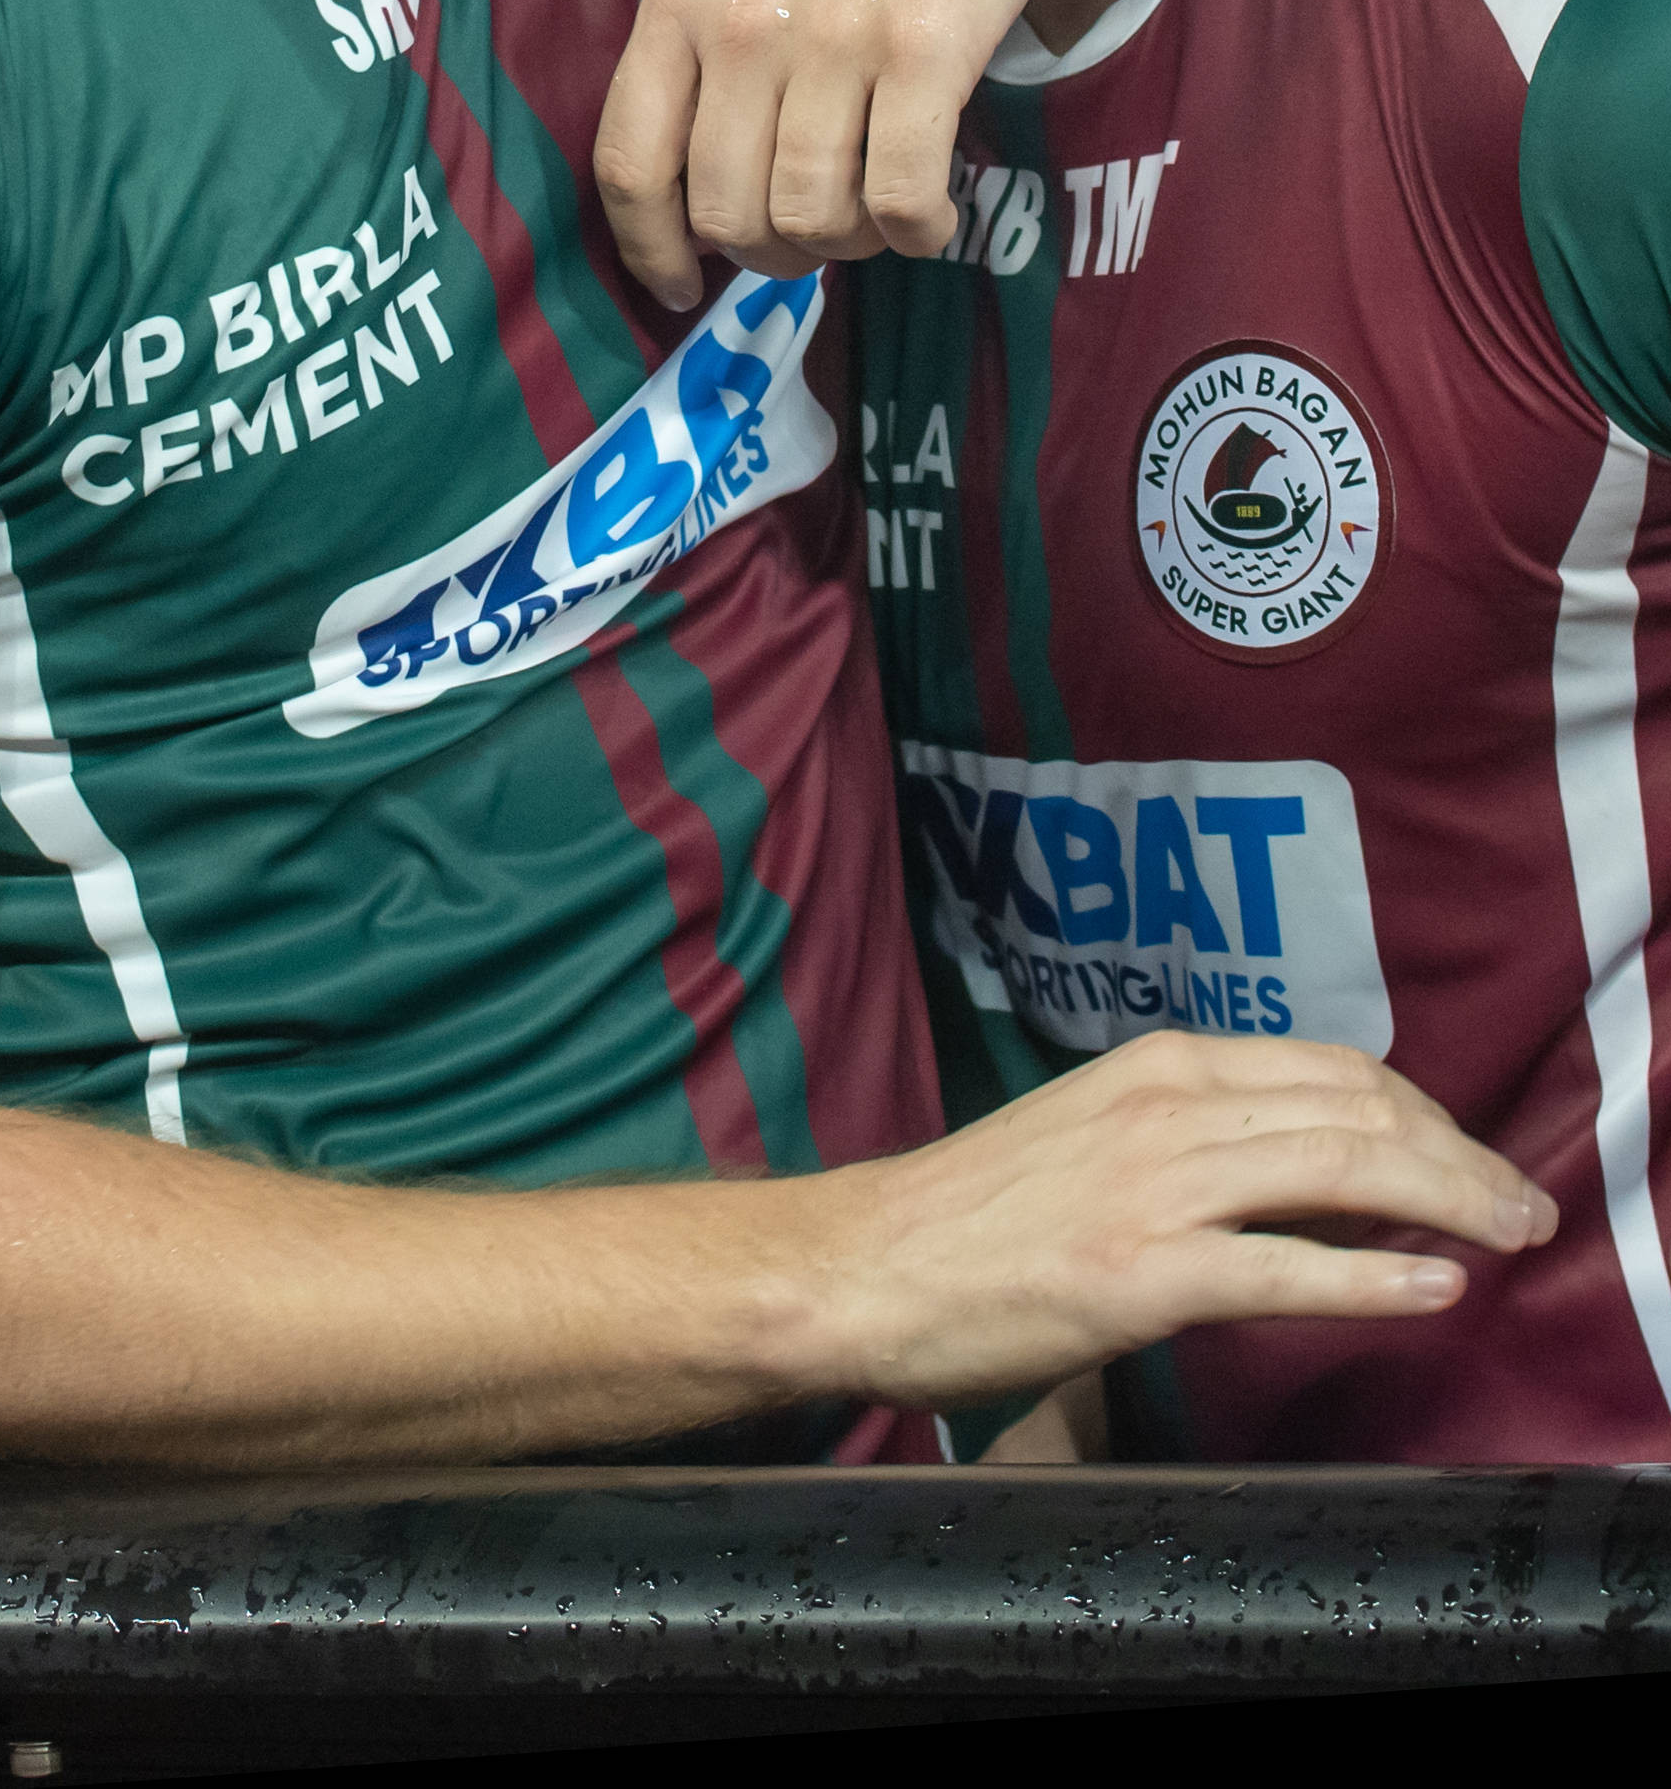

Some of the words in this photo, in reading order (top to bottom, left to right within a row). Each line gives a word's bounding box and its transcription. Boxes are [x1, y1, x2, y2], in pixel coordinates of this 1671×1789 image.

[1065, 139, 1181, 278] TM
[48, 315, 186, 427] MP
[208, 165, 439, 374] BIRLA
[61, 268, 454, 506] CEMENT
[1144, 366, 1245, 490] MOHUN
[1255, 366, 1368, 489] BAGAN
[1162, 565, 1249, 636] SUPER
[1261, 562, 1357, 635] GIANT
